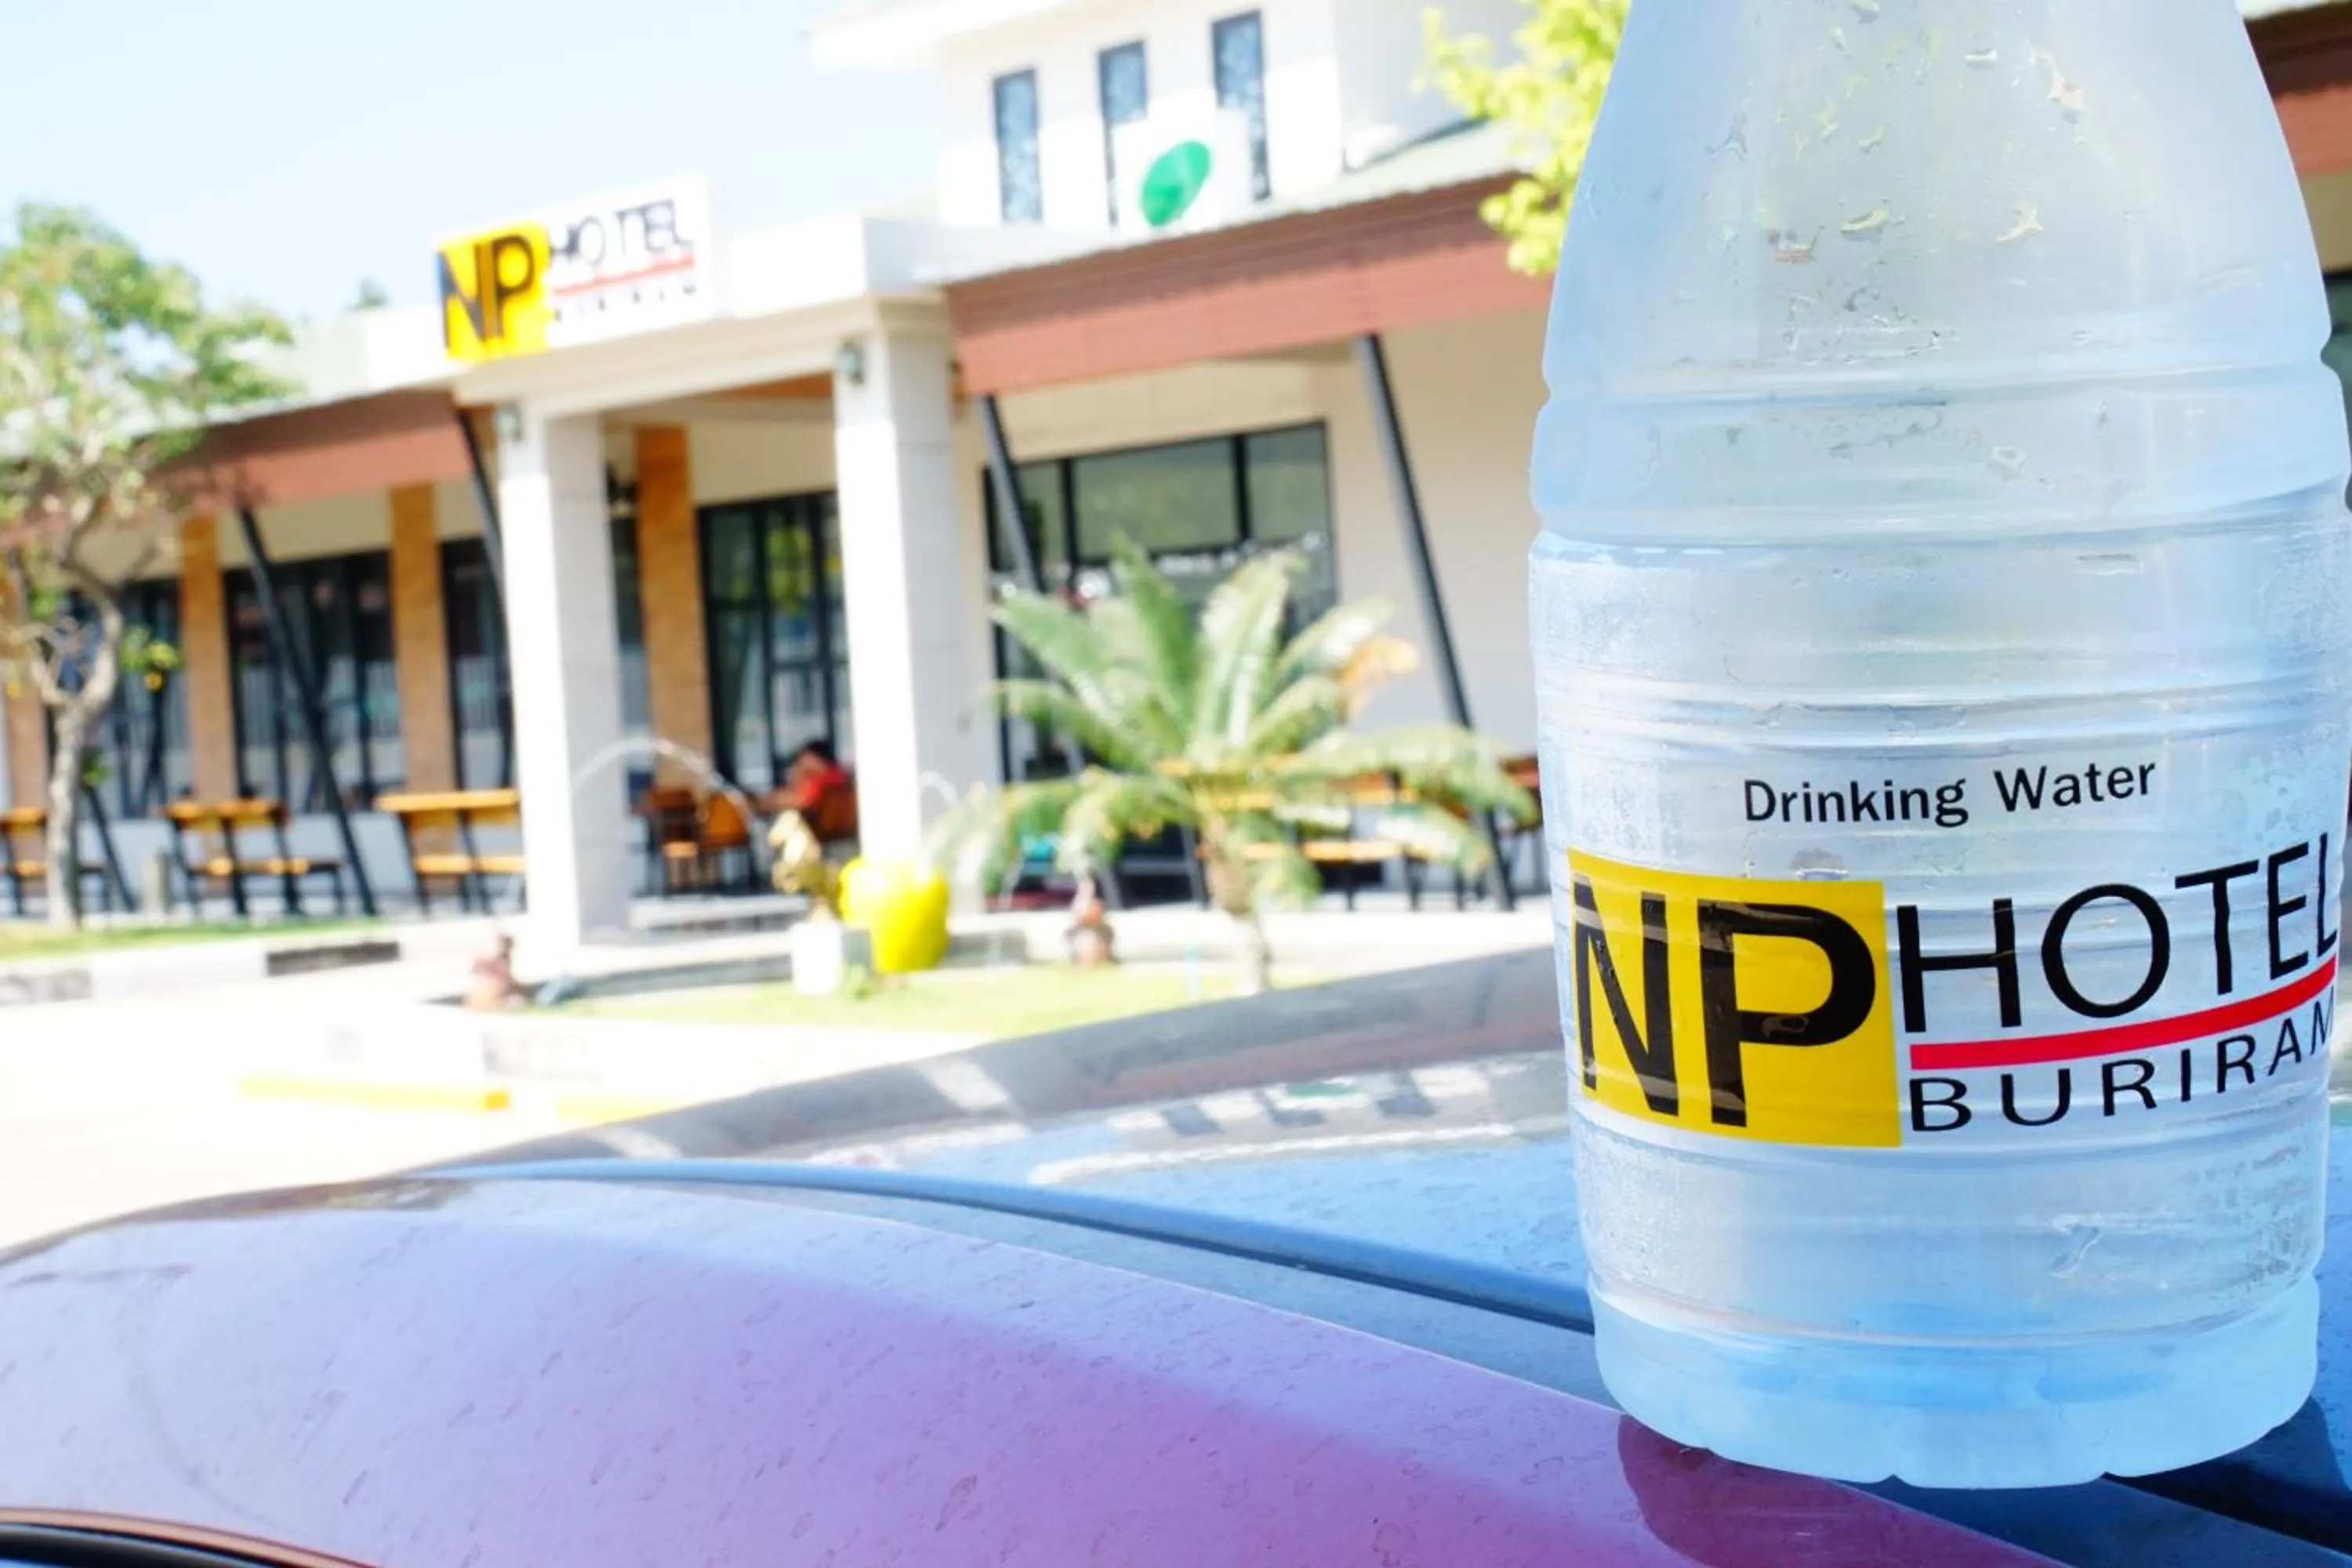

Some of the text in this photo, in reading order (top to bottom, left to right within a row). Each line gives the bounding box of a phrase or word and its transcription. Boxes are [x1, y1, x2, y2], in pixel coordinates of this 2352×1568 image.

[438, 234, 535, 351] NP
[1744, 762, 2156, 828] Drinking Water
[1573, 833, 2338, 1128] NP HOTEL
[1910, 987, 2334, 1131] BURIRAM
